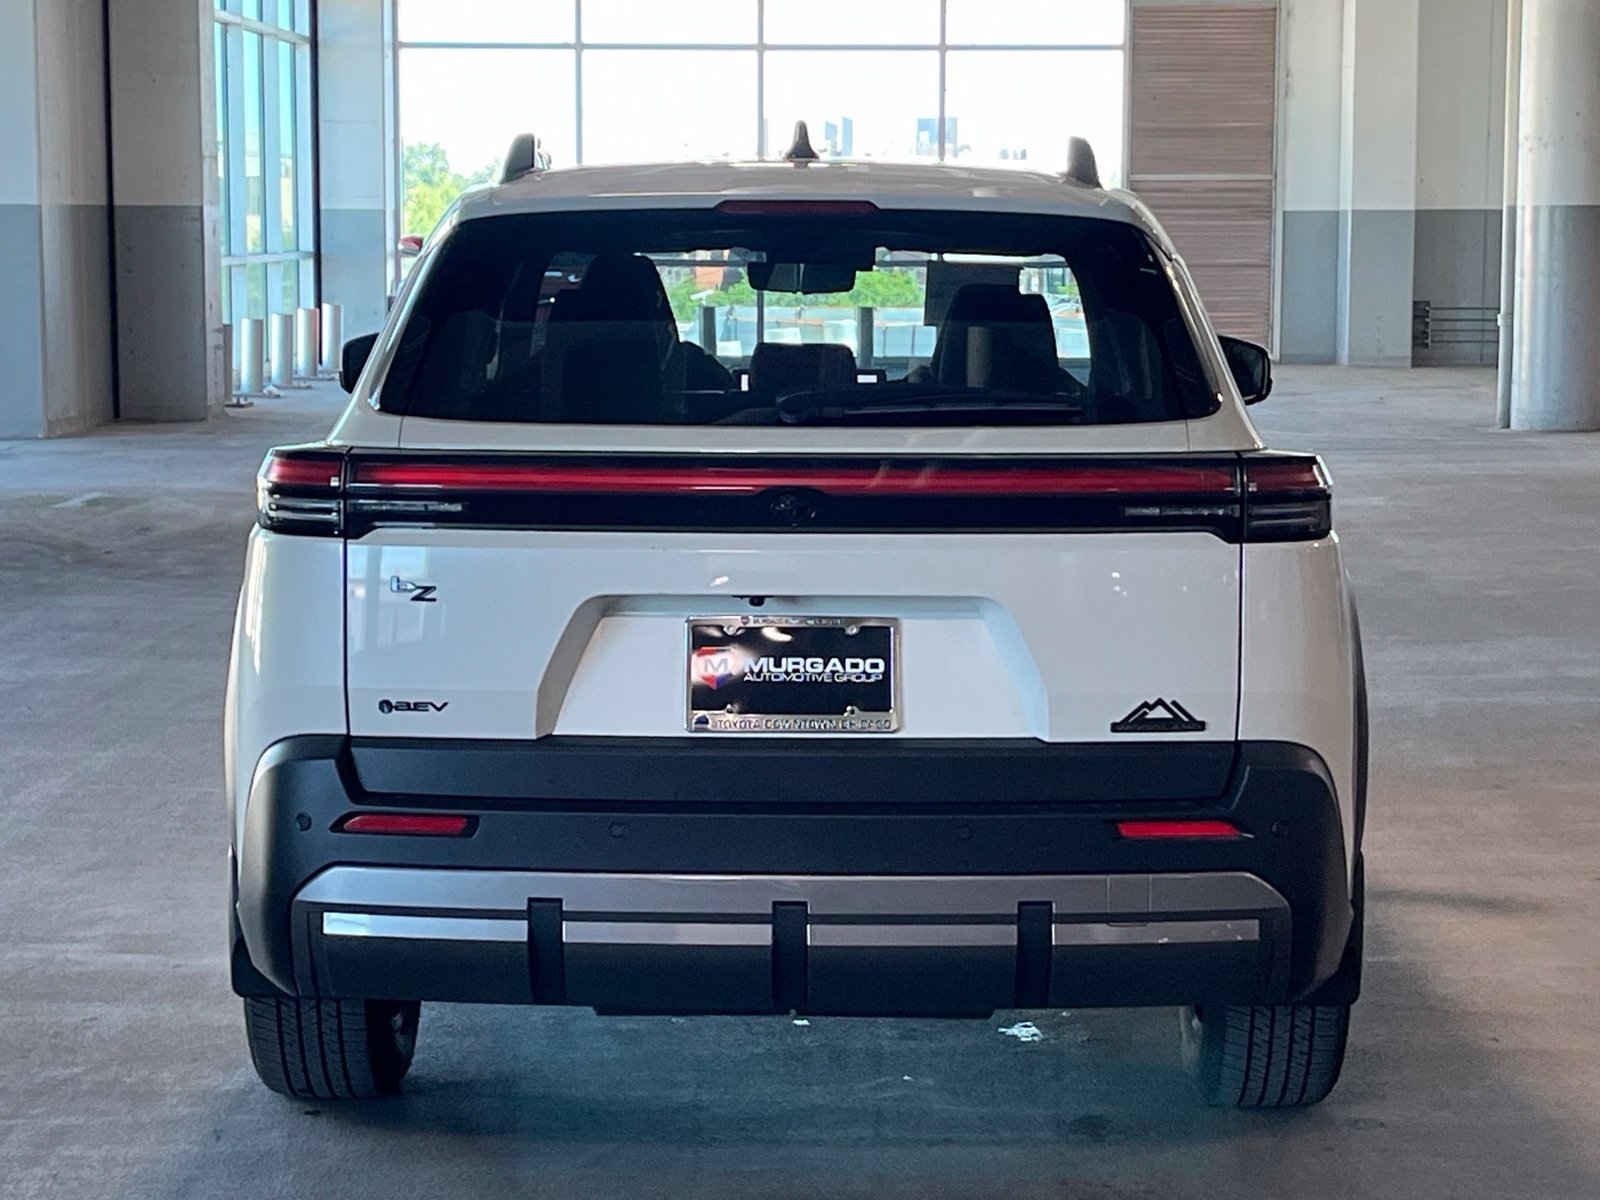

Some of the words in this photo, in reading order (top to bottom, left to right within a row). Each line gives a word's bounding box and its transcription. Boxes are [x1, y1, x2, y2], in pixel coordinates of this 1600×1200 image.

[704, 658, 729, 673] M
[743, 657, 885, 673] MURGADO
[743, 672, 832, 682] AUTOMOTIVE
[834, 672, 883, 683] GROUP
[718, 719, 760, 730] TOYOTA
[764, 719, 836, 730] DOWNTOWN
